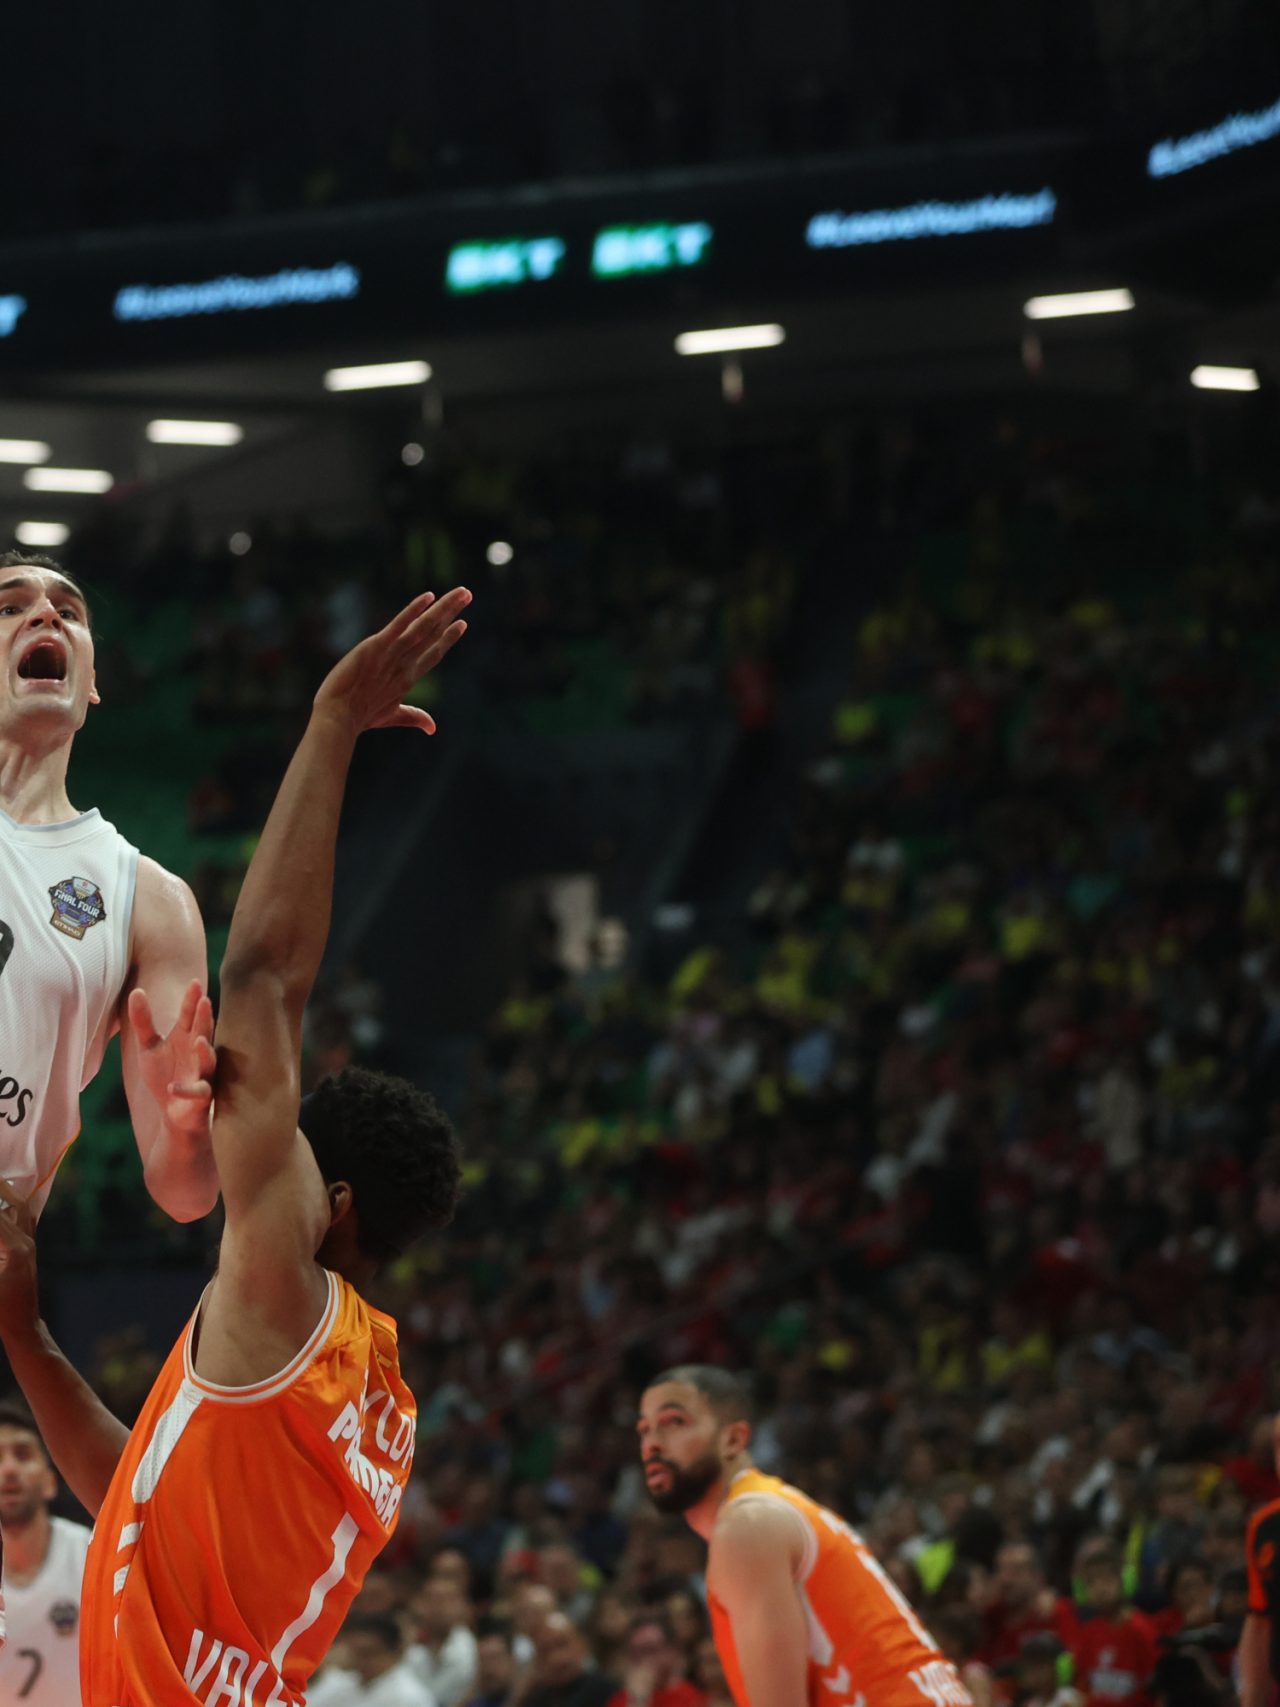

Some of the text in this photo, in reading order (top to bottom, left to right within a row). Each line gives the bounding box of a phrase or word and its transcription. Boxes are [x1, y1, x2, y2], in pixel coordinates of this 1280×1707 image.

[77, 900, 101, 918] FOUR
[270, 1511, 360, 1678] 1
[16, 1648, 43, 1699] 7
